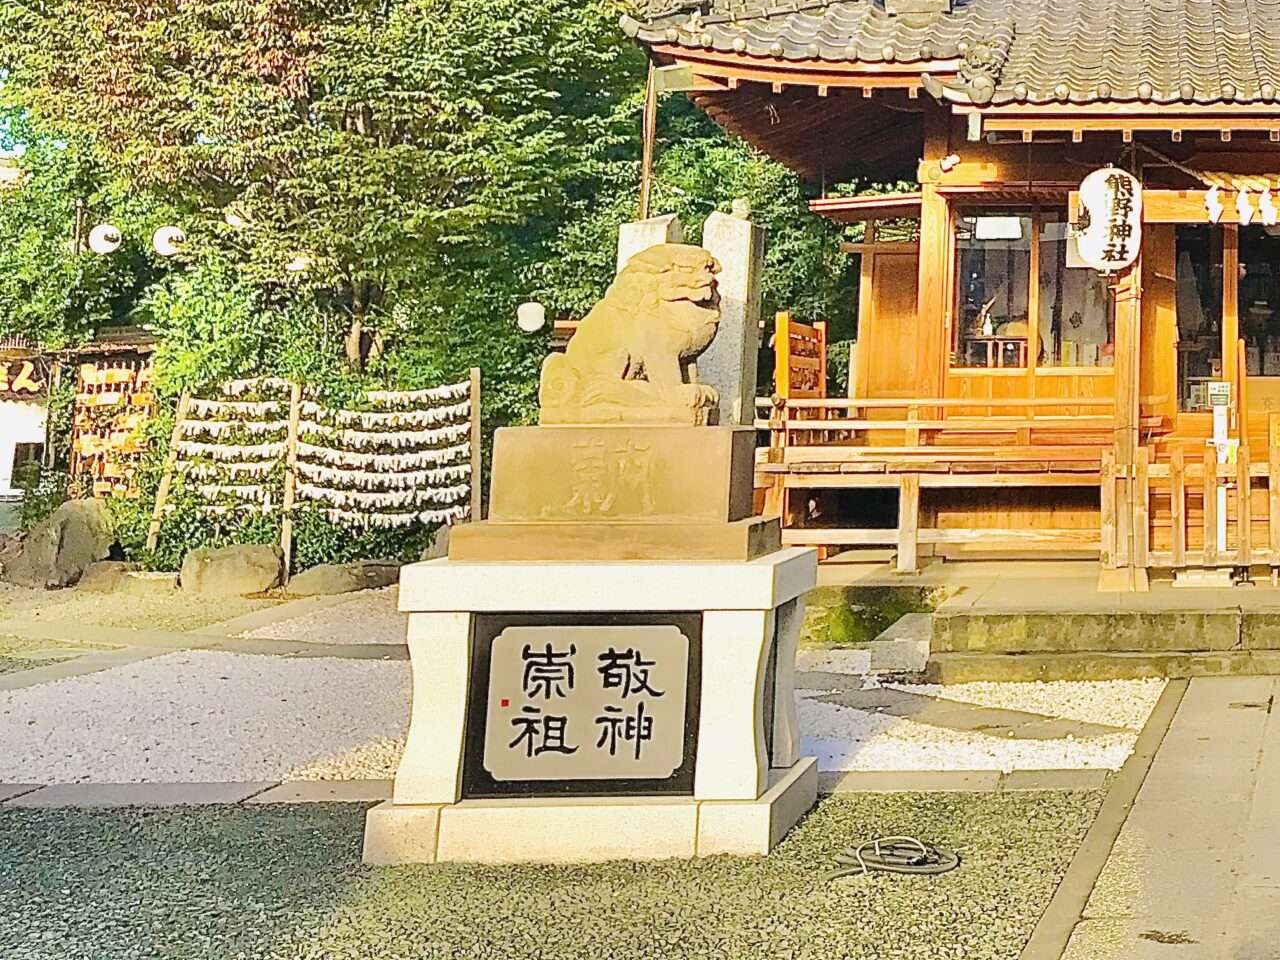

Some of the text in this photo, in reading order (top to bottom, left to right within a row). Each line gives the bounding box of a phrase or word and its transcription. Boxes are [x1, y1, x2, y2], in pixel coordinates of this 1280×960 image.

[1102, 173, 1134, 262] 熊野神社
[509, 643, 580, 757] 崇祖
[595, 647, 665, 760] 敬神
